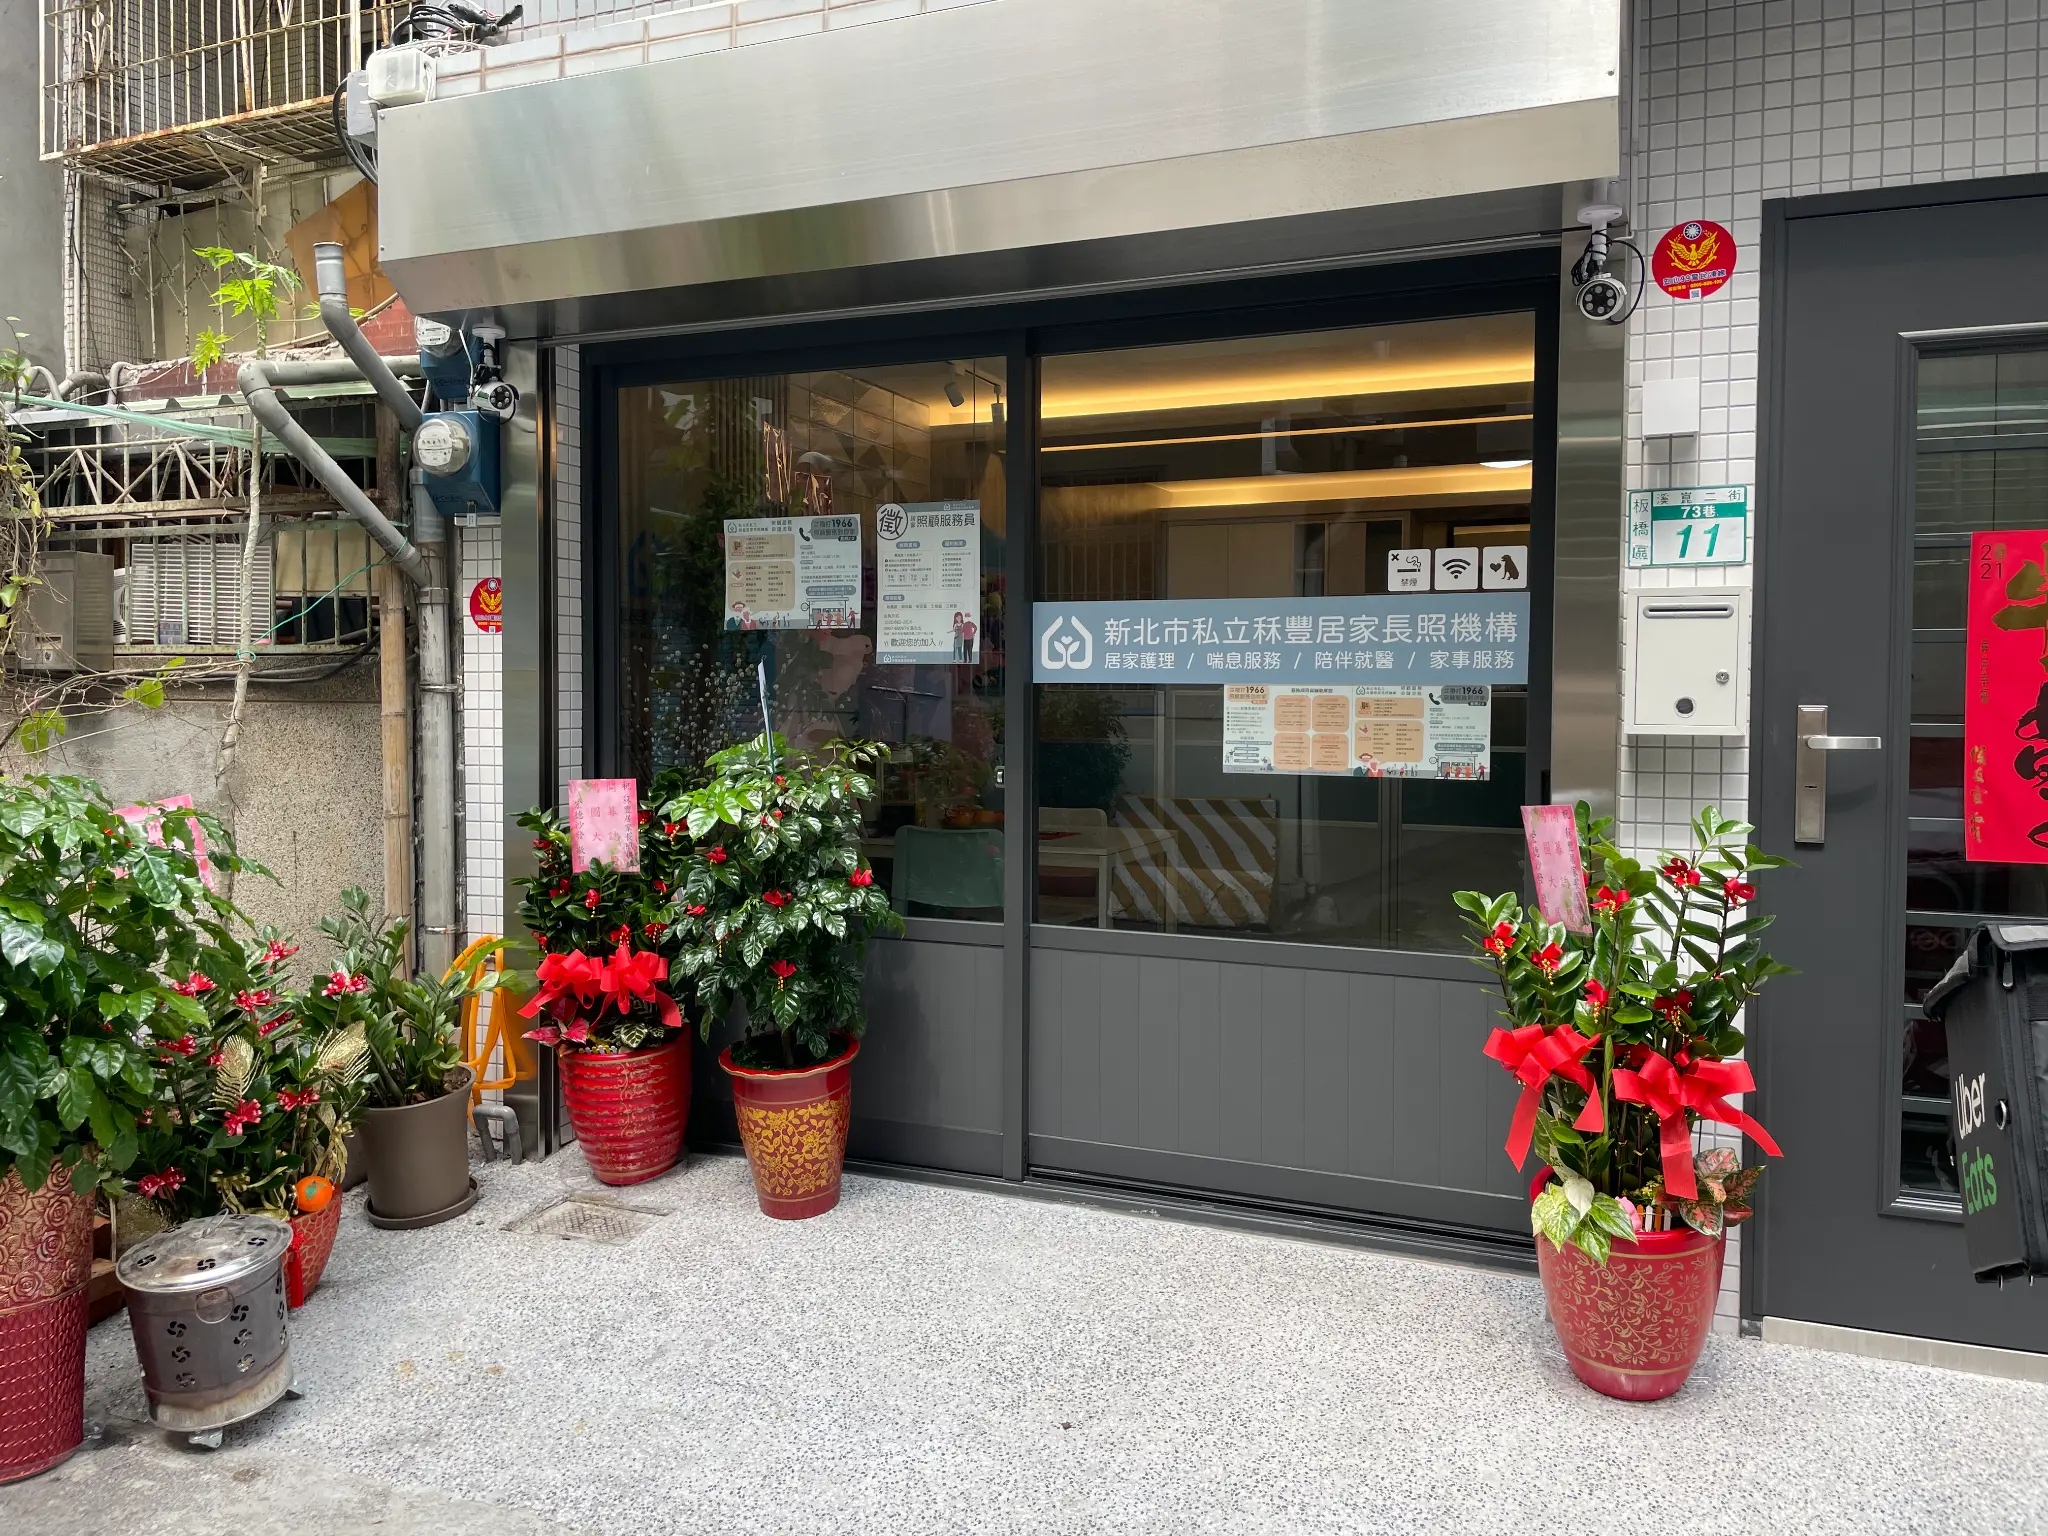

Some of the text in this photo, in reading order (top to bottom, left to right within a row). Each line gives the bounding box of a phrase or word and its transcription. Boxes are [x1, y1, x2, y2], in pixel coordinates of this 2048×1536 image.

[1656, 489, 1742, 505] 溪崑二街
[917, 513, 976, 528] 照顧服務員
[1681, 506, 1716, 519] 73巷
[832, 518, 853, 528] 1966
[879, 507, 904, 537] 徵
[1632, 499, 1649, 560] 板橋區
[1676, 523, 1721, 559] 11
[1980, 562, 2002, 579] 21
[1104, 611, 1518, 646] 新北市私立秝豐居家長照機構
[1104, 652, 1176, 669] 居家護理
[1206, 651, 1281, 670] 喘息服務
[1315, 651, 1394, 669] 陪伴就醫
[1430, 650, 1515, 669] 家事服務
[1246, 686, 1265, 694] 1966
[1462, 686, 1484, 695] 1966
[1955, 1072, 1985, 1140] Uber
[1962, 1146, 1998, 1215] Eats
